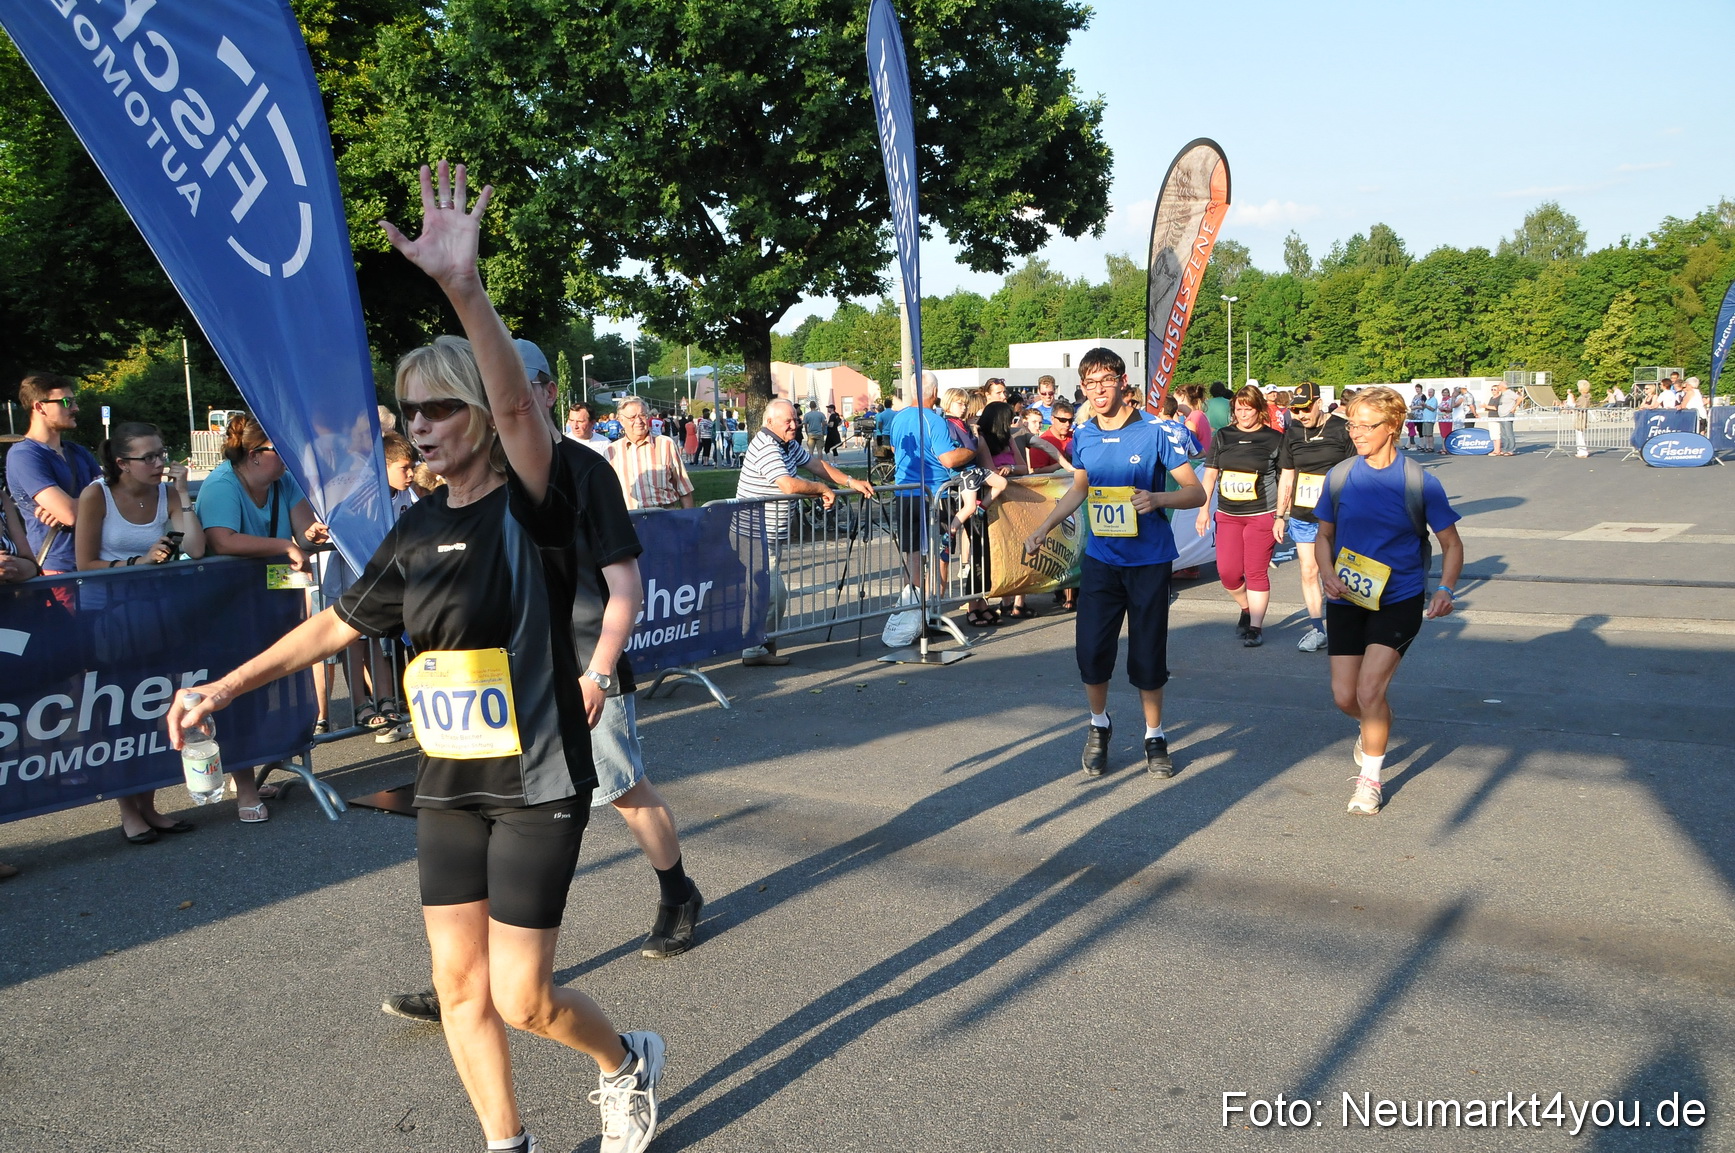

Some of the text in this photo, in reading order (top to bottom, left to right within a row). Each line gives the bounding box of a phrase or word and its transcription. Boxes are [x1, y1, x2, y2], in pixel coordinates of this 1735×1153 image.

[1457, 439, 1490, 447] Fischer
[1660, 447, 1705, 456] Fischer
[1222, 481, 1253, 493] 1102
[1093, 504, 1125, 524] 701
[1338, 567, 1373, 598] 633
[411, 687, 509, 731] 1070
